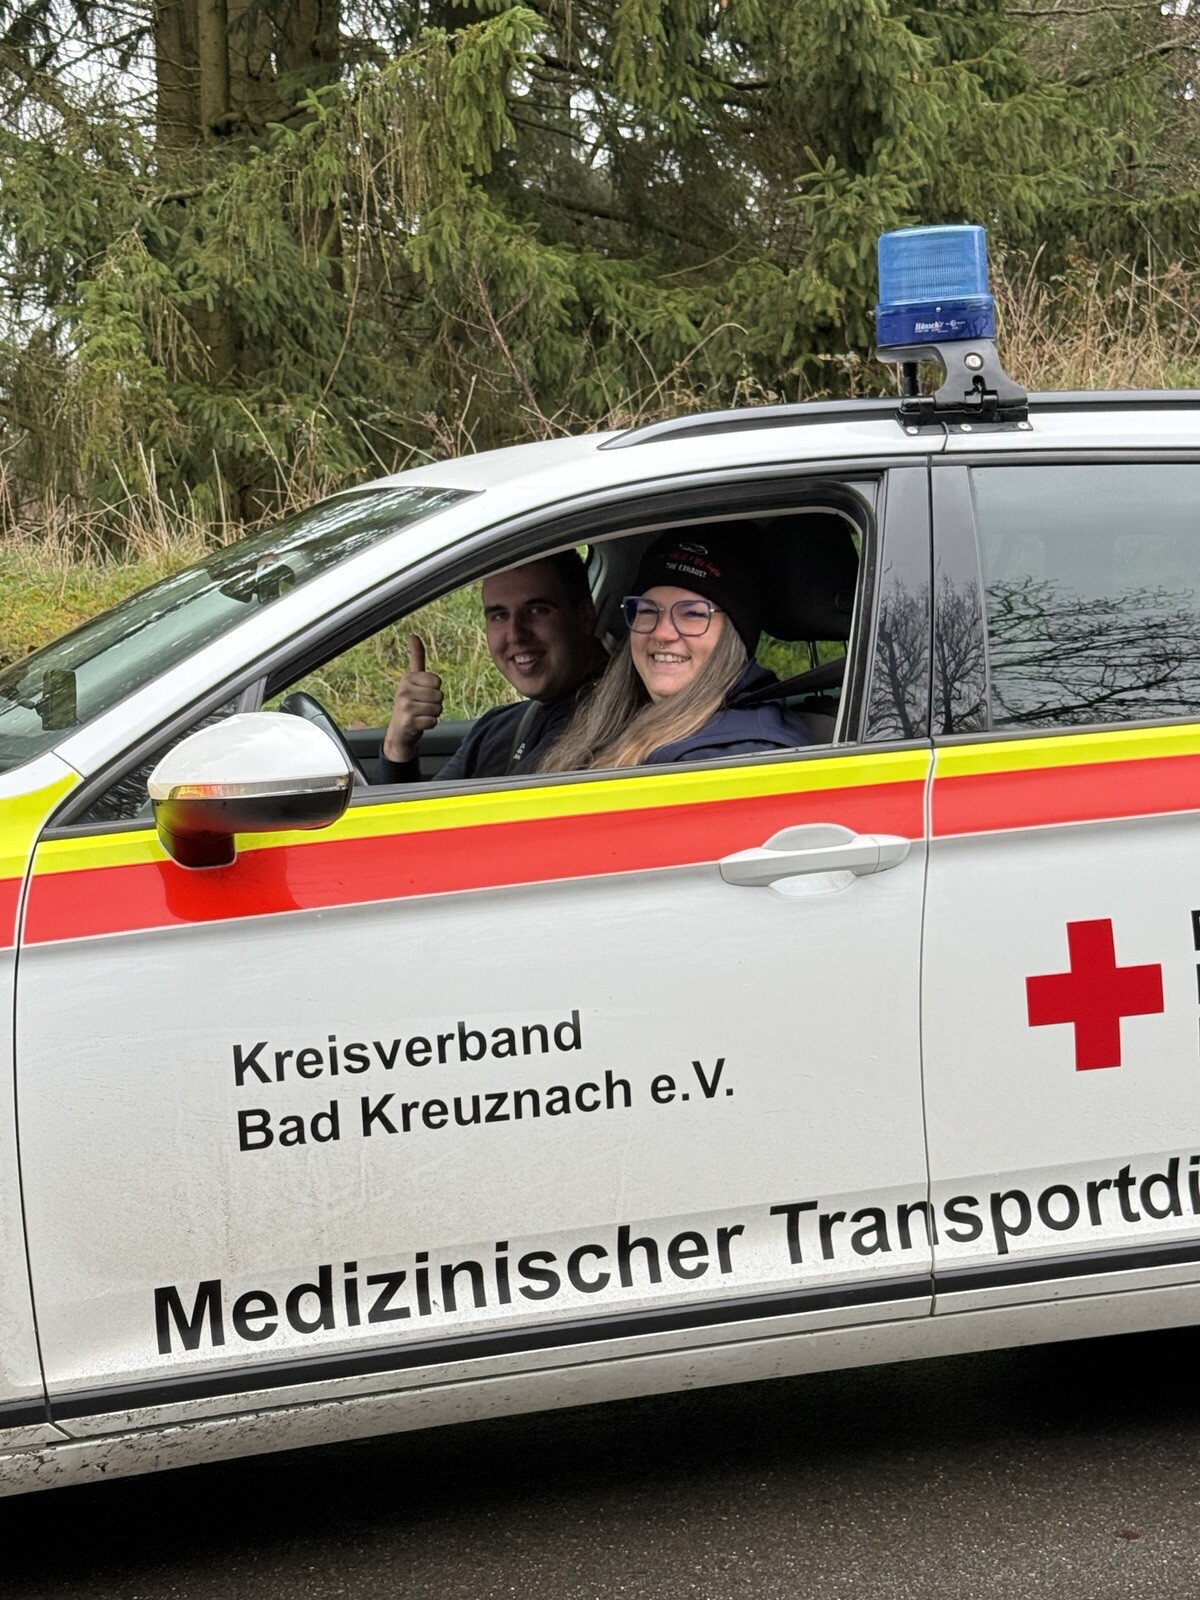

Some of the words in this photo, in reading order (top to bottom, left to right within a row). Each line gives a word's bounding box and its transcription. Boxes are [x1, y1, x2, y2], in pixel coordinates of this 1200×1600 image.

[666, 562, 677, 570] THE
[678, 564, 707, 577] EXHAUST
[233, 1010, 582, 1087] Kreisverband
[238, 1100, 340, 1152] Bad
[361, 1069, 632, 1137] Kreuznach
[651, 1057, 735, 1105] e.V.
[155, 1224, 745, 1355] Medizinischer
